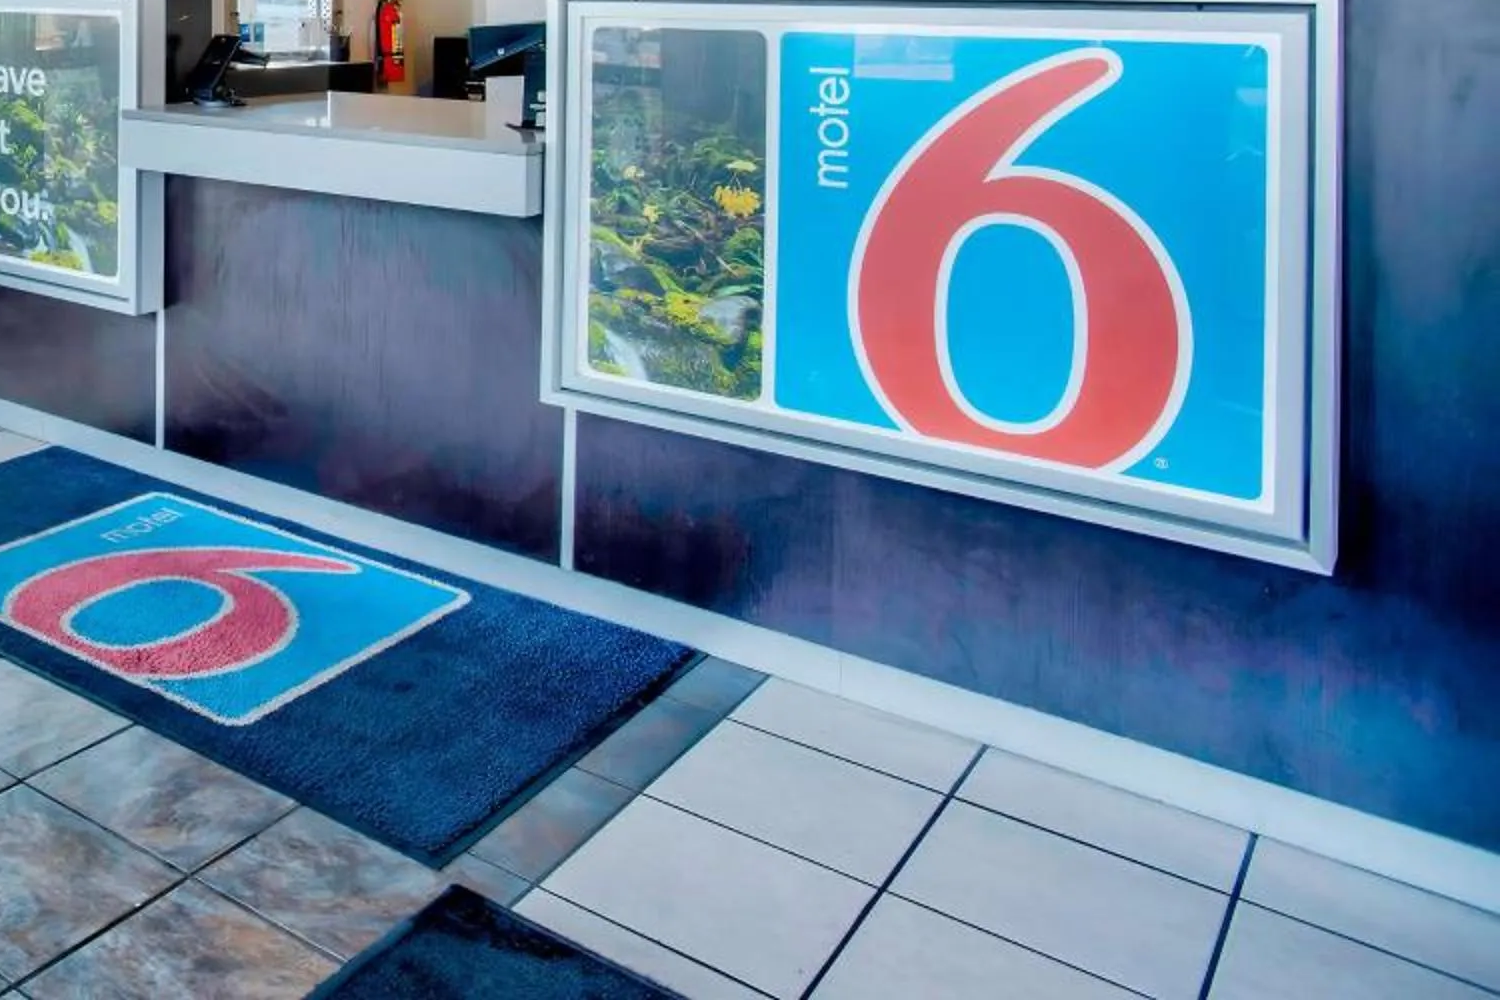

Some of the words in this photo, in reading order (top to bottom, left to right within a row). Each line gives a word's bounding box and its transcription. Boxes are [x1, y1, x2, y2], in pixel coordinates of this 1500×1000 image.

[809, 66, 850, 189] motel
[847, 47, 1194, 476] 6
[100, 507, 183, 543] motel
[2, 545, 363, 681] 6
